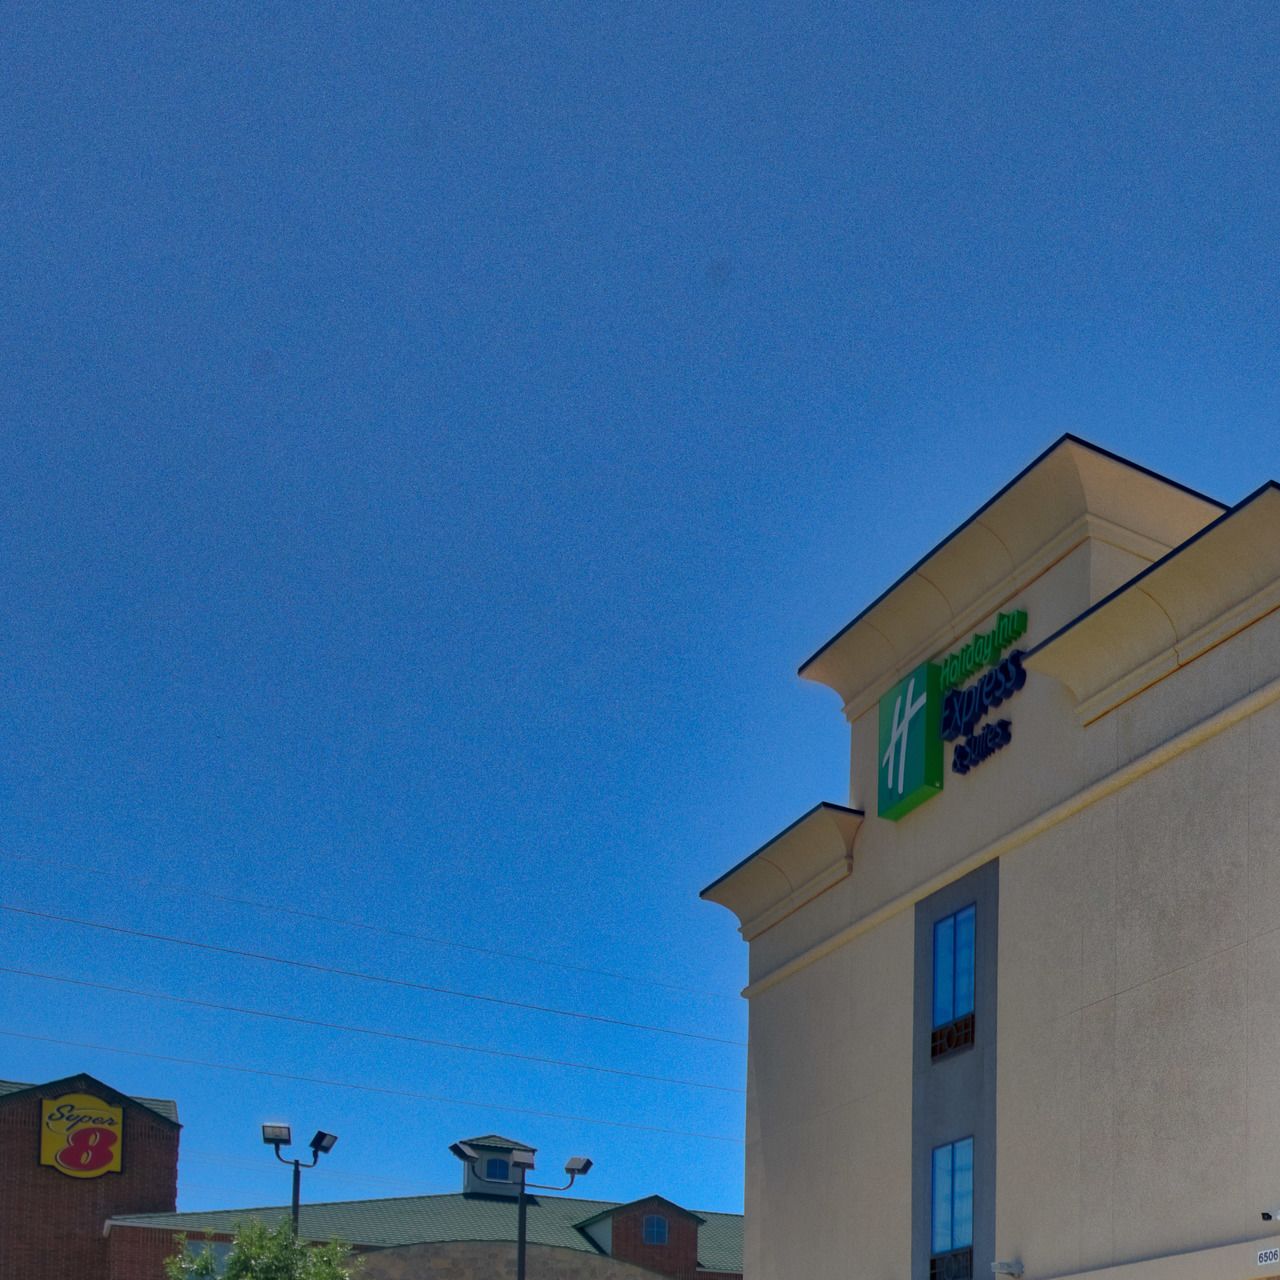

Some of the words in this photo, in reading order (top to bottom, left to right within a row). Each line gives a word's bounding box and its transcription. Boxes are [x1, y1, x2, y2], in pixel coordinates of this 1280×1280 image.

[940, 633, 996, 691] Holiday
[995, 609, 1026, 648] Inn
[940, 650, 1025, 741] Express
[47, 1104, 118, 1131] Super
[55, 1127, 118, 1172] 8
[1258, 1249, 1279, 1264] 6506
